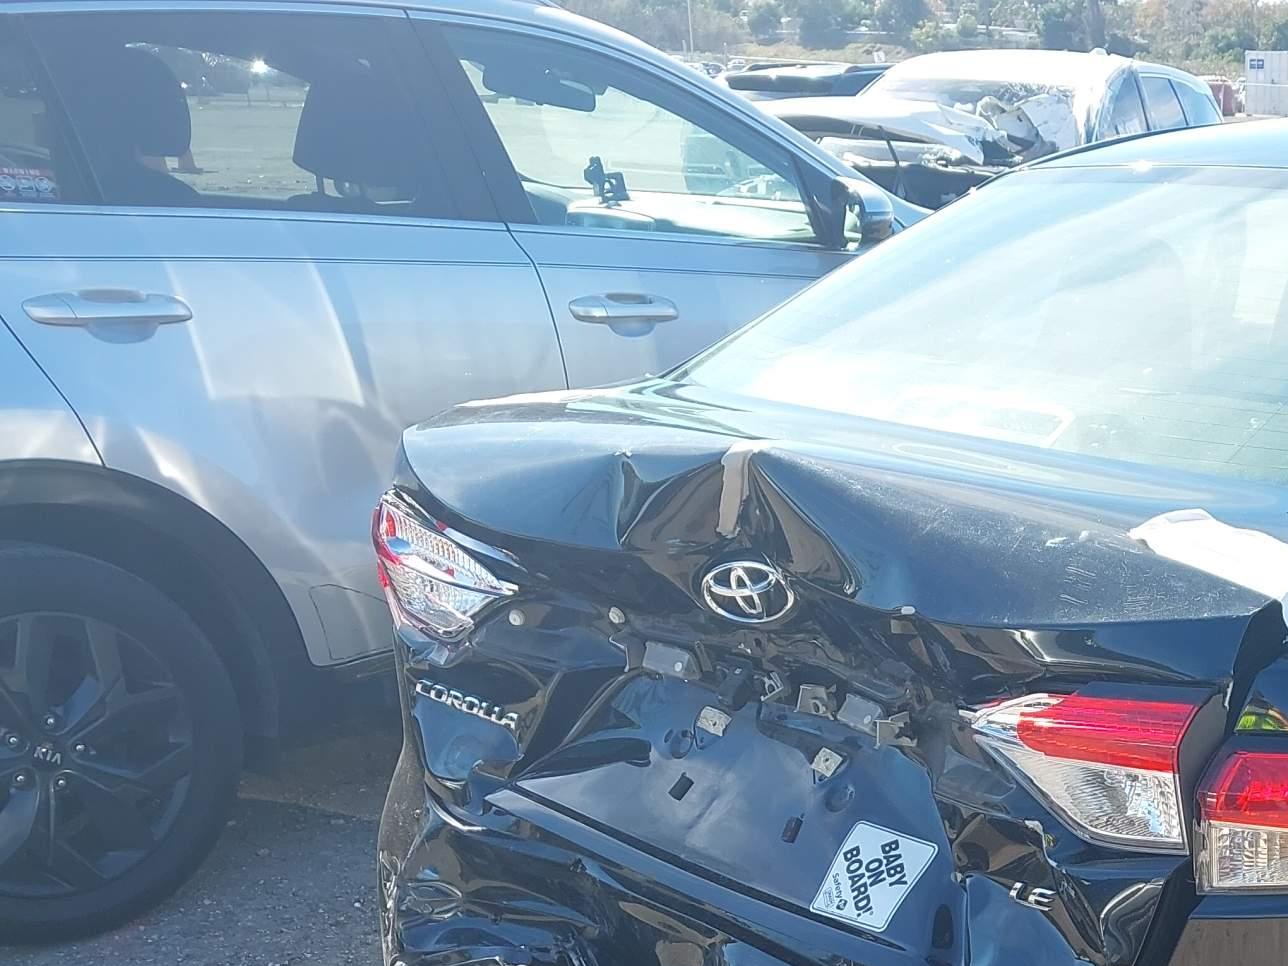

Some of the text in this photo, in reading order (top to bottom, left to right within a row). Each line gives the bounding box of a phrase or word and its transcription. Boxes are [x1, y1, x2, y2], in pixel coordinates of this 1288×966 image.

[415, 679, 520, 730] COROLLA
[33, 746, 62, 765] KIA
[864, 857, 887, 888] ON
[881, 838, 909, 887] BABY
[832, 872, 844, 899] Safety
[842, 845, 873, 918] BOARD!
[1009, 882, 1057, 911] LE
